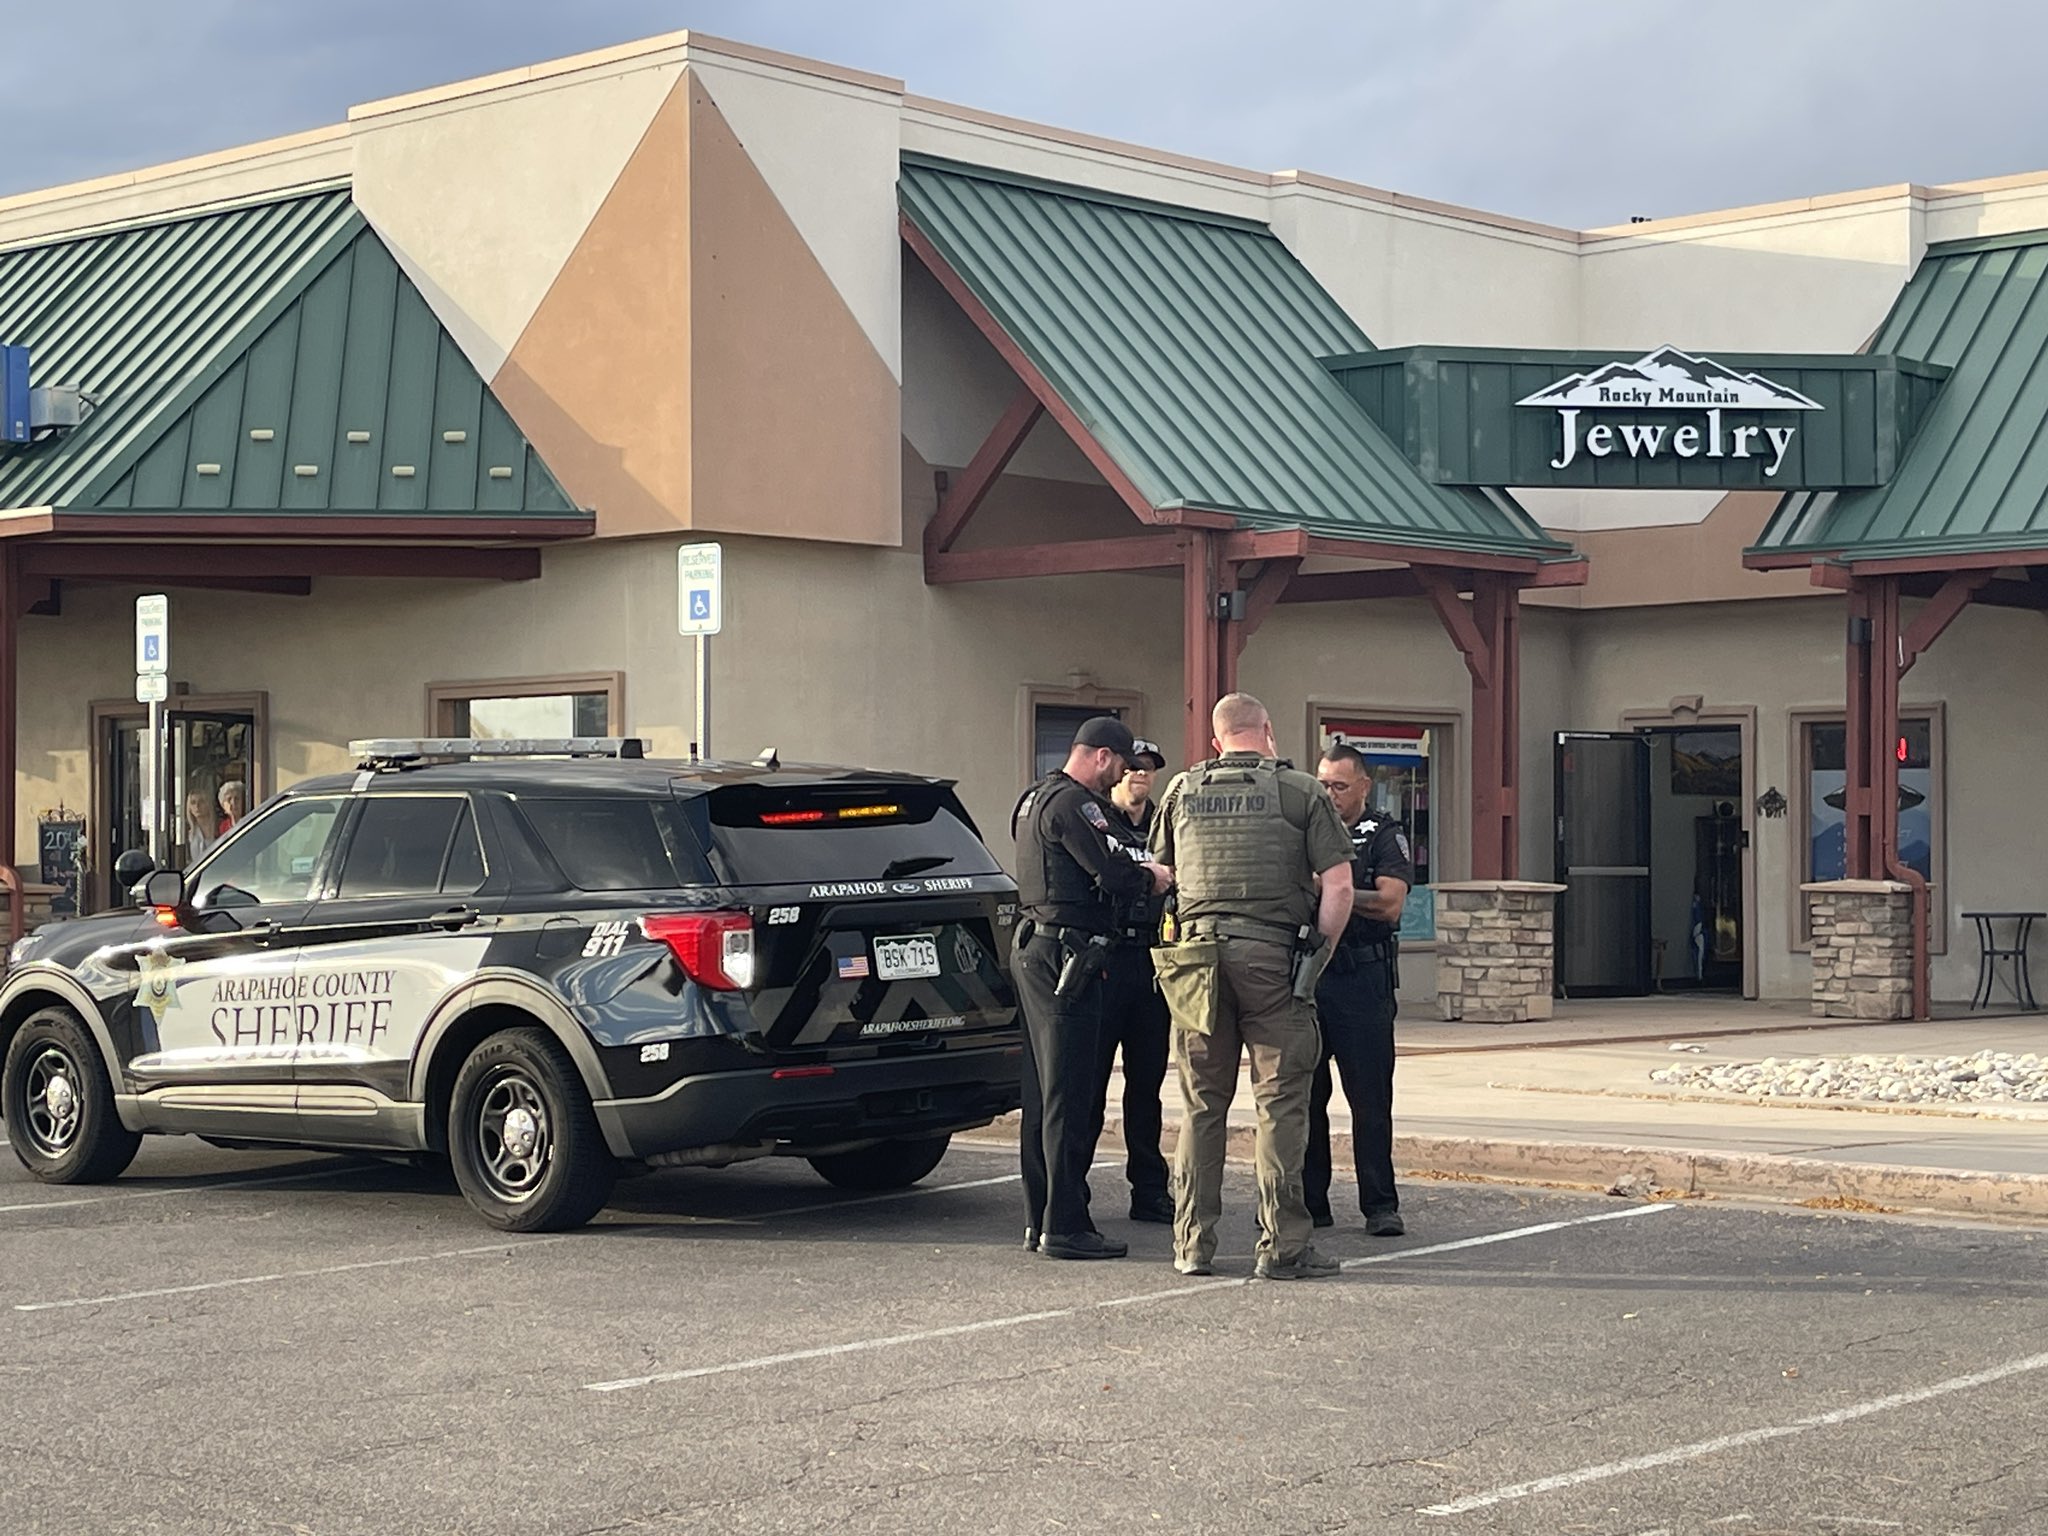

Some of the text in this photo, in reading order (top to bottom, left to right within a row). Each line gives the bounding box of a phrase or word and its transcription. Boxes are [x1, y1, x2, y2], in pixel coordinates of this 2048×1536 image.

[1599, 387, 1740, 406] Rocky Mountain
[1550, 408, 1796, 477] Jewelry
[1187, 795, 1265, 815] SHERIFF K9
[809, 882, 887, 898] ARAPAHOE
[924, 877, 974, 892] SHERIFF
[768, 906, 800, 925] 258
[591, 921, 629, 936] DIAL
[582, 935, 626, 957] 911
[211, 970, 397, 1003] ARAPAHOE COUNTY
[210, 1000, 393, 1050] SHERIFF
[640, 1043, 671, 1063] 258
